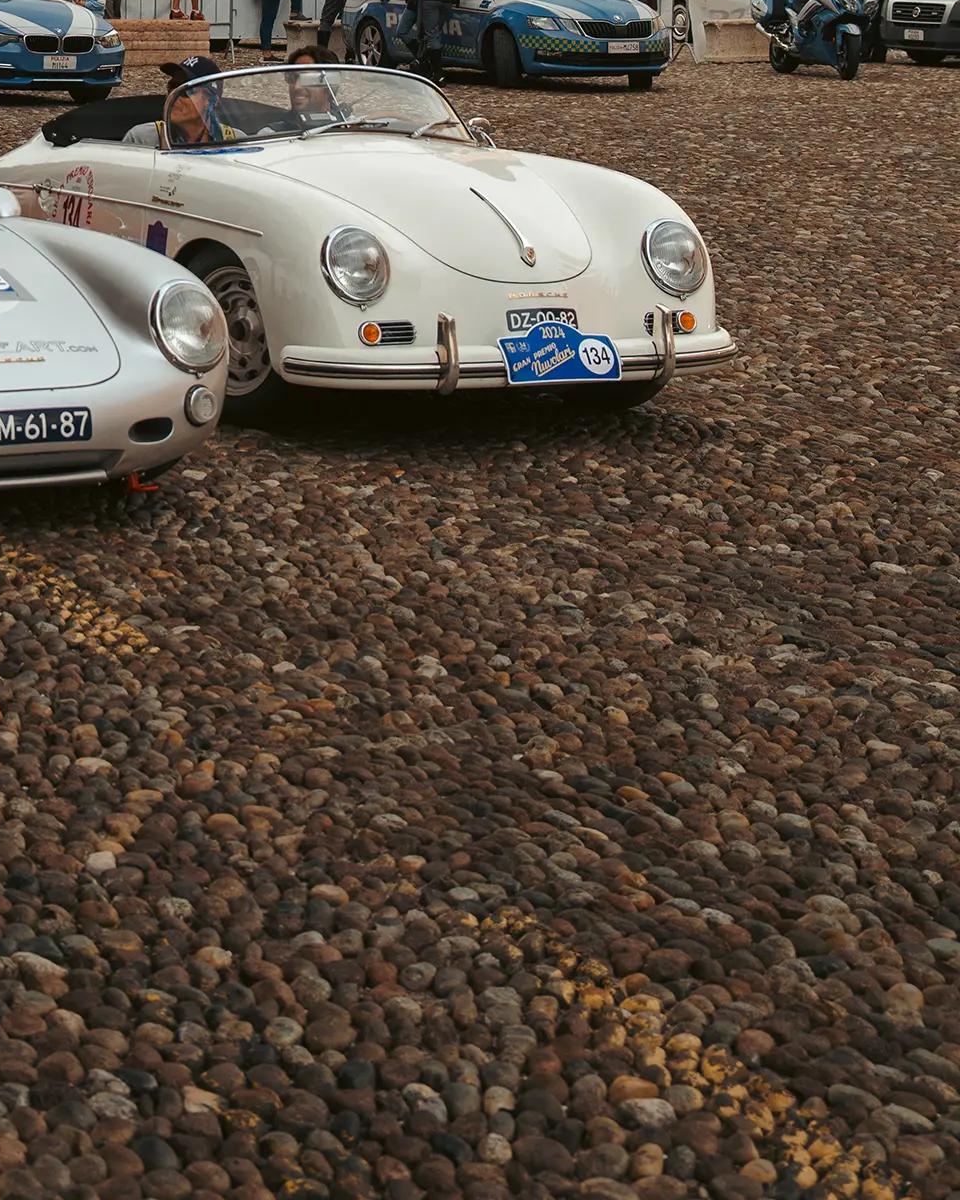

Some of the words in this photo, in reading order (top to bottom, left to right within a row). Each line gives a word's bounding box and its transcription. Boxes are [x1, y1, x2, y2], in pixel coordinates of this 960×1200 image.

[539, 326, 566, 339] 2024
[512, 357, 531, 372] GRAN
[533, 342, 557, 360] PREMIO
[531, 344, 576, 377] Nuvolari
[582, 347, 610, 365] 134
